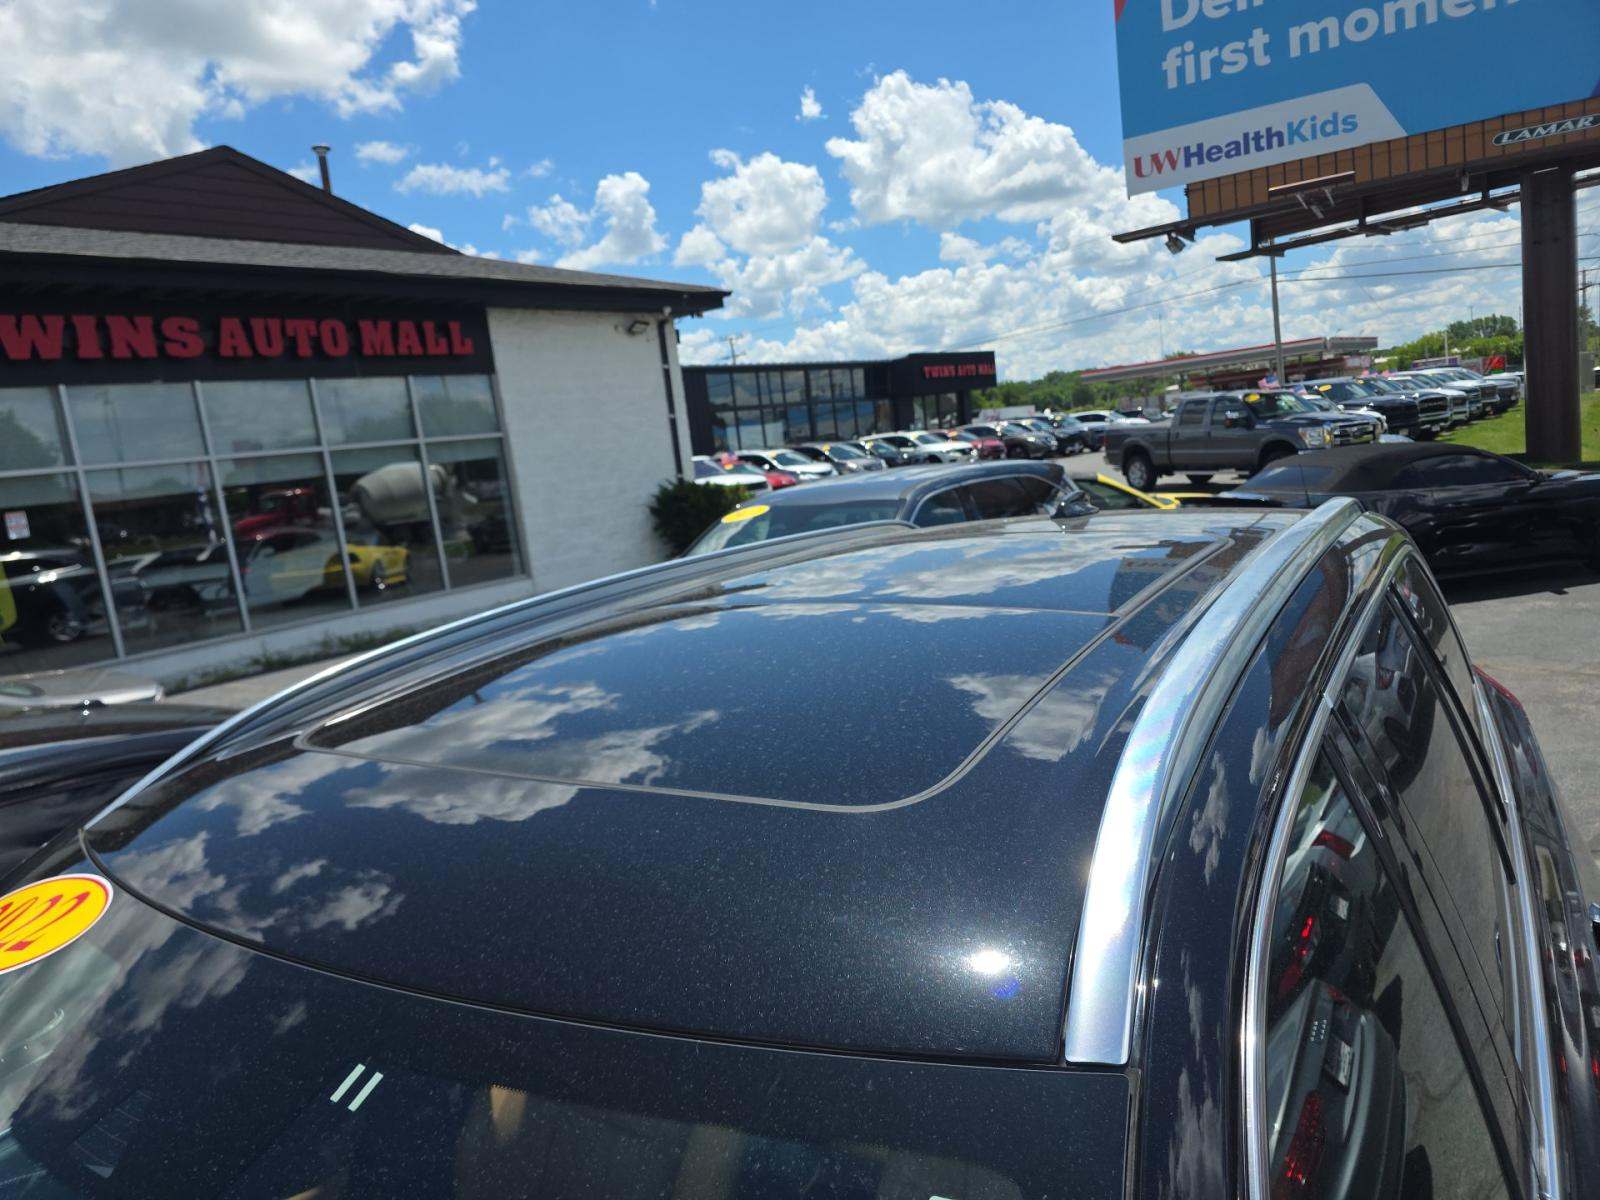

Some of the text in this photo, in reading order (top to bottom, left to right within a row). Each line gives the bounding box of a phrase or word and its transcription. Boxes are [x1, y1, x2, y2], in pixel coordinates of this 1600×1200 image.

[1162, 27, 1271, 90] first
[1501, 116, 1595, 143] LAMAR
[0, 314, 475, 360] WINS AUTO MALL
